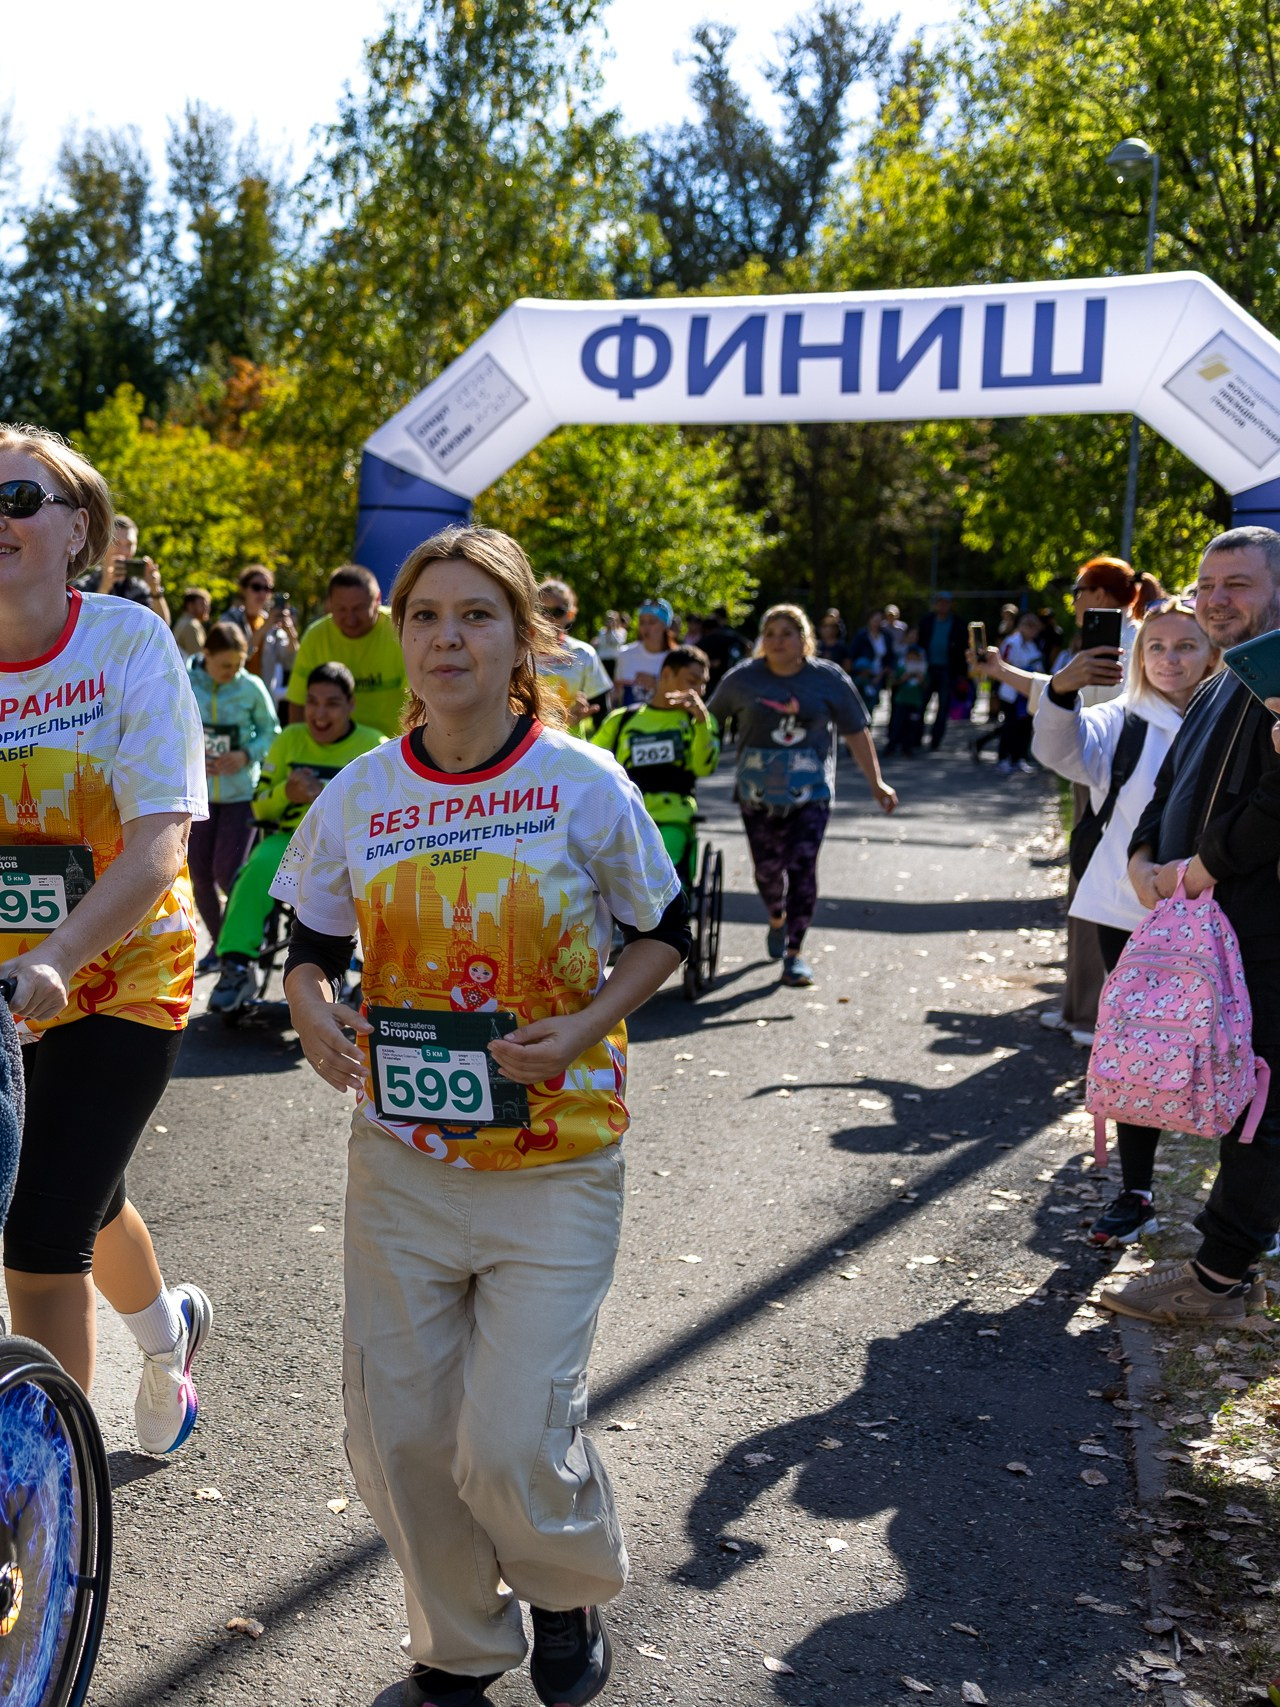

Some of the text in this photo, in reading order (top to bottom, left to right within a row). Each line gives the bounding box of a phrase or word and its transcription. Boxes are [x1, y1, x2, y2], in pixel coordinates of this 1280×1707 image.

[580, 296, 1108, 400] ФИНИШ
[635, 745, 670, 762] 262
[369, 785, 560, 838] БЕЗ ГРАНИЦ
[366, 815, 556, 861] БЛАГОТВОРИТЕЛЬНЫЙ
[430, 847, 483, 867] ЗАБЕГ
[389, 1021, 436, 1031] серия забегов
[386, 1065, 483, 1113] 599
